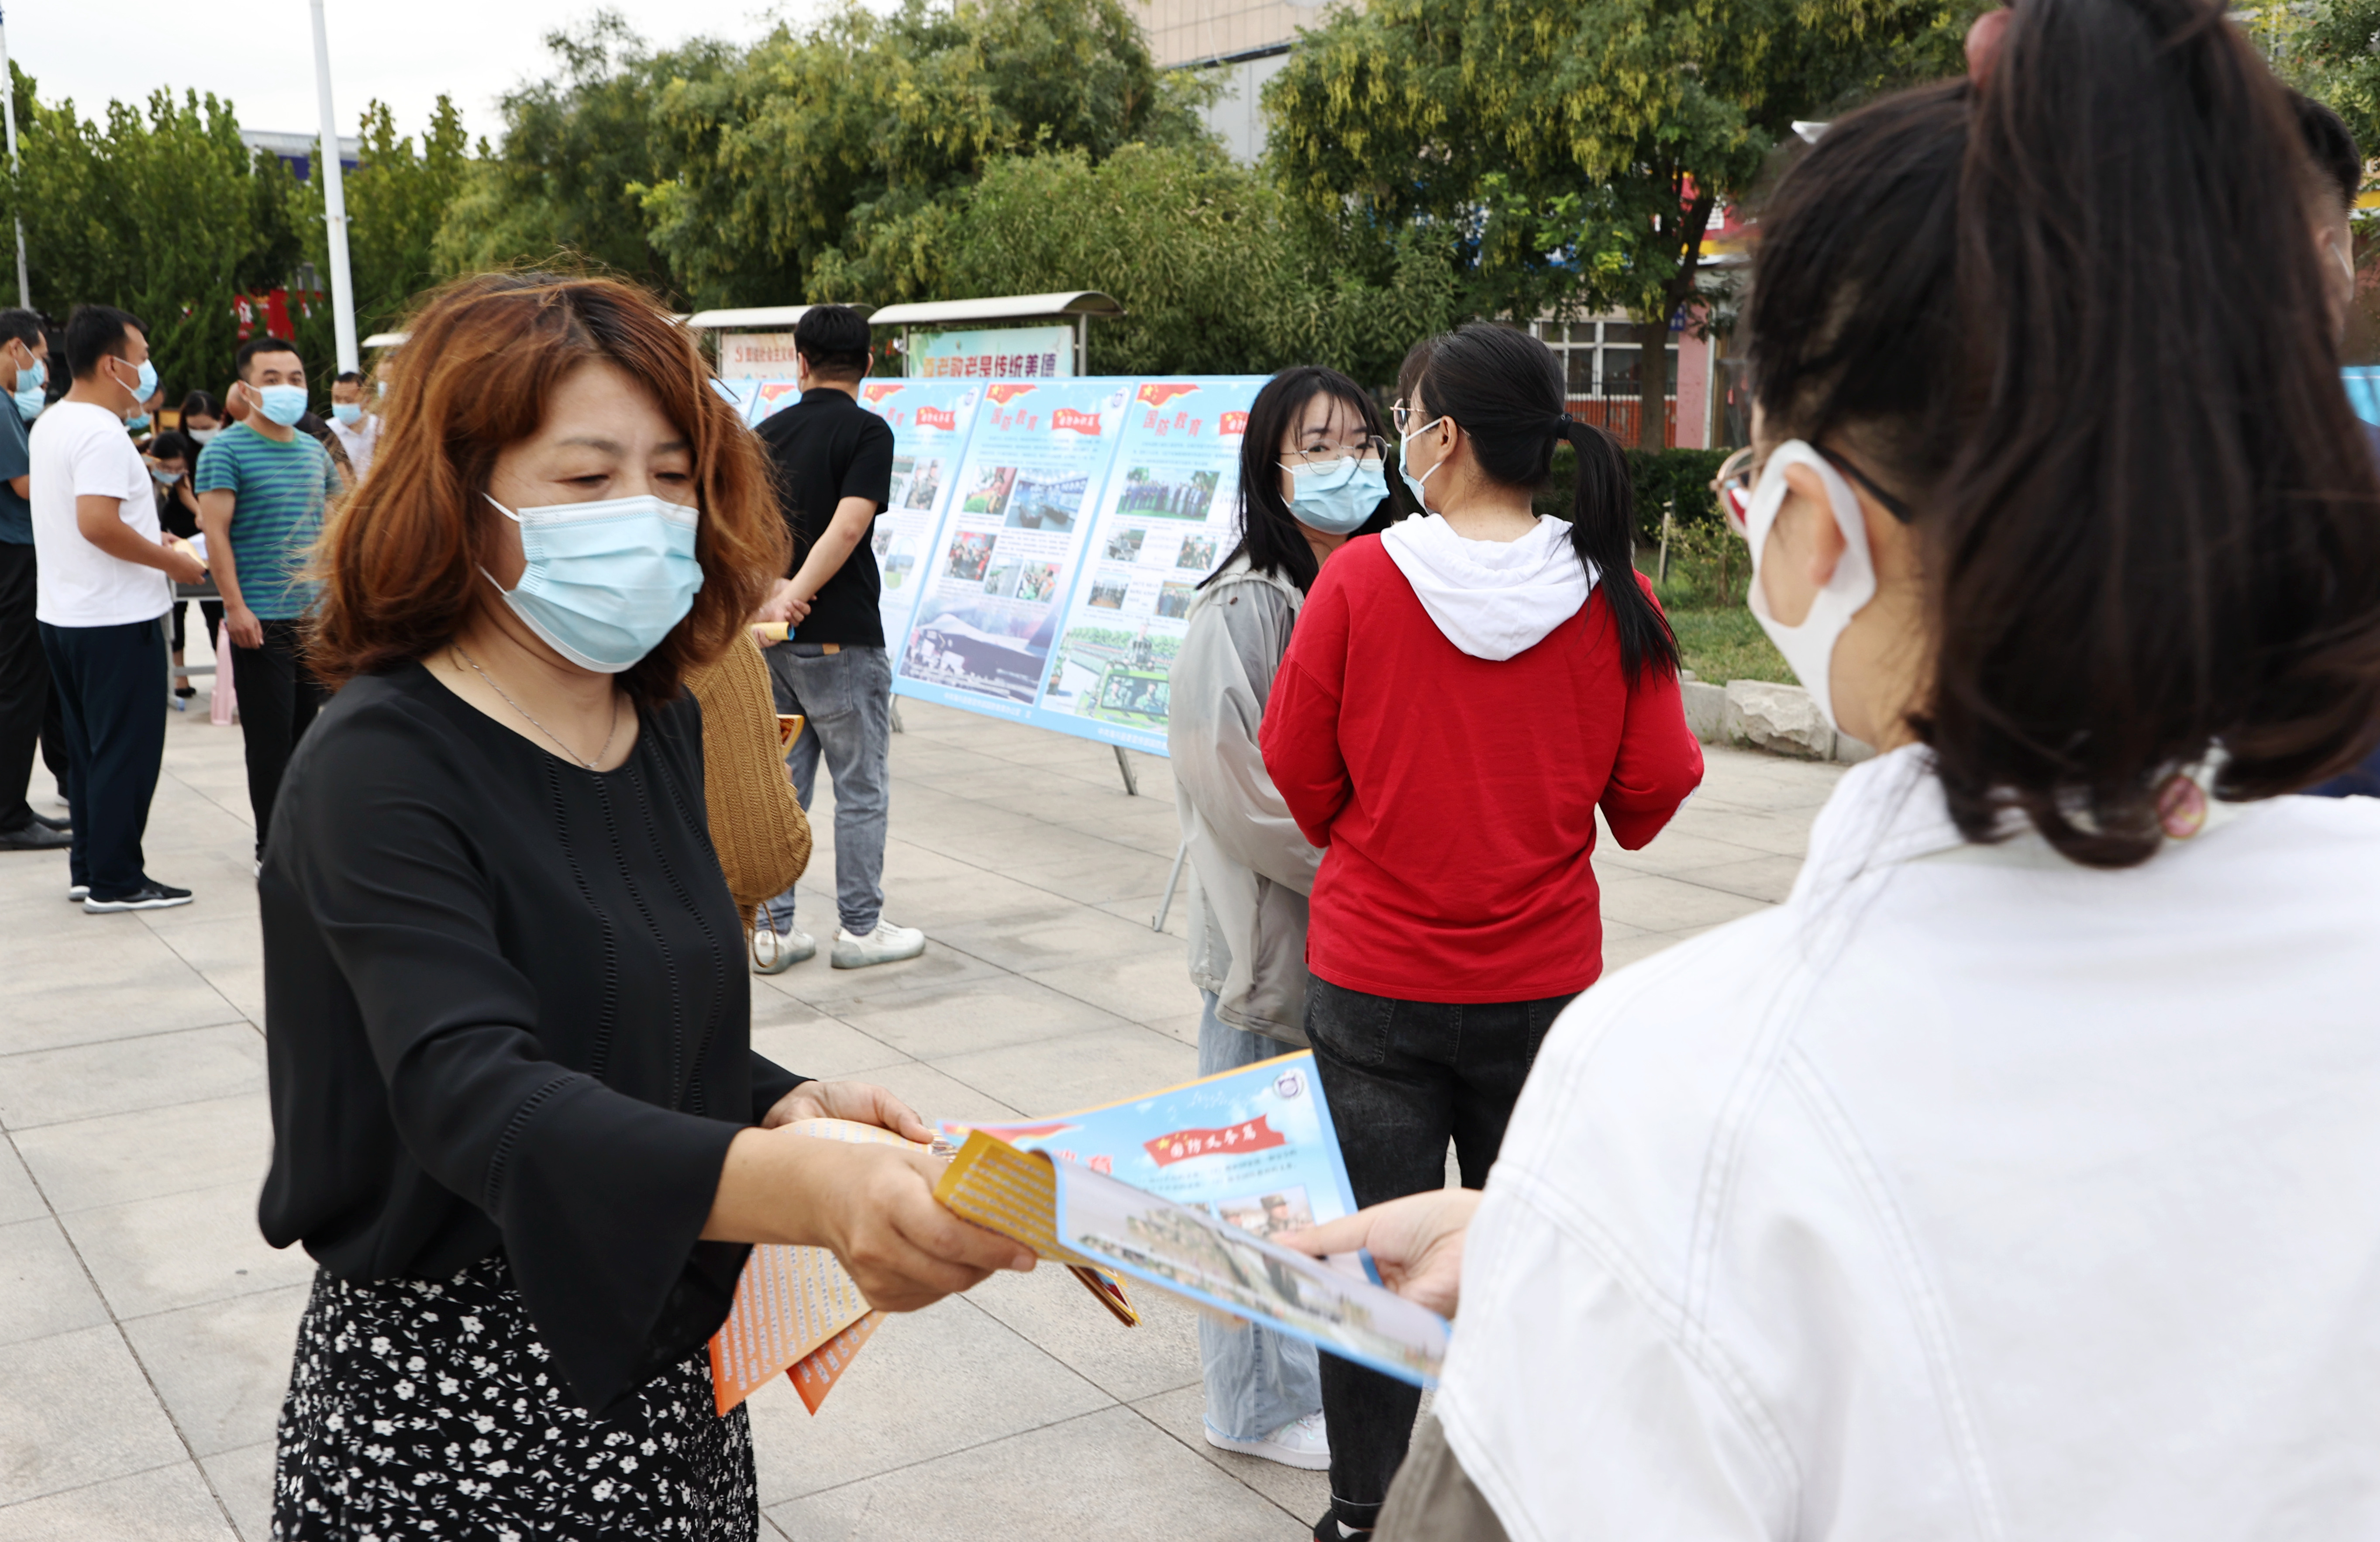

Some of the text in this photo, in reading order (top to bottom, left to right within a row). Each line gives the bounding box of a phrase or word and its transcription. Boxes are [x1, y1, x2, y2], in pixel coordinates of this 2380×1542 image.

[990, 407, 1039, 431] 国防教育
[1143, 410, 1203, 437] 国防教育
